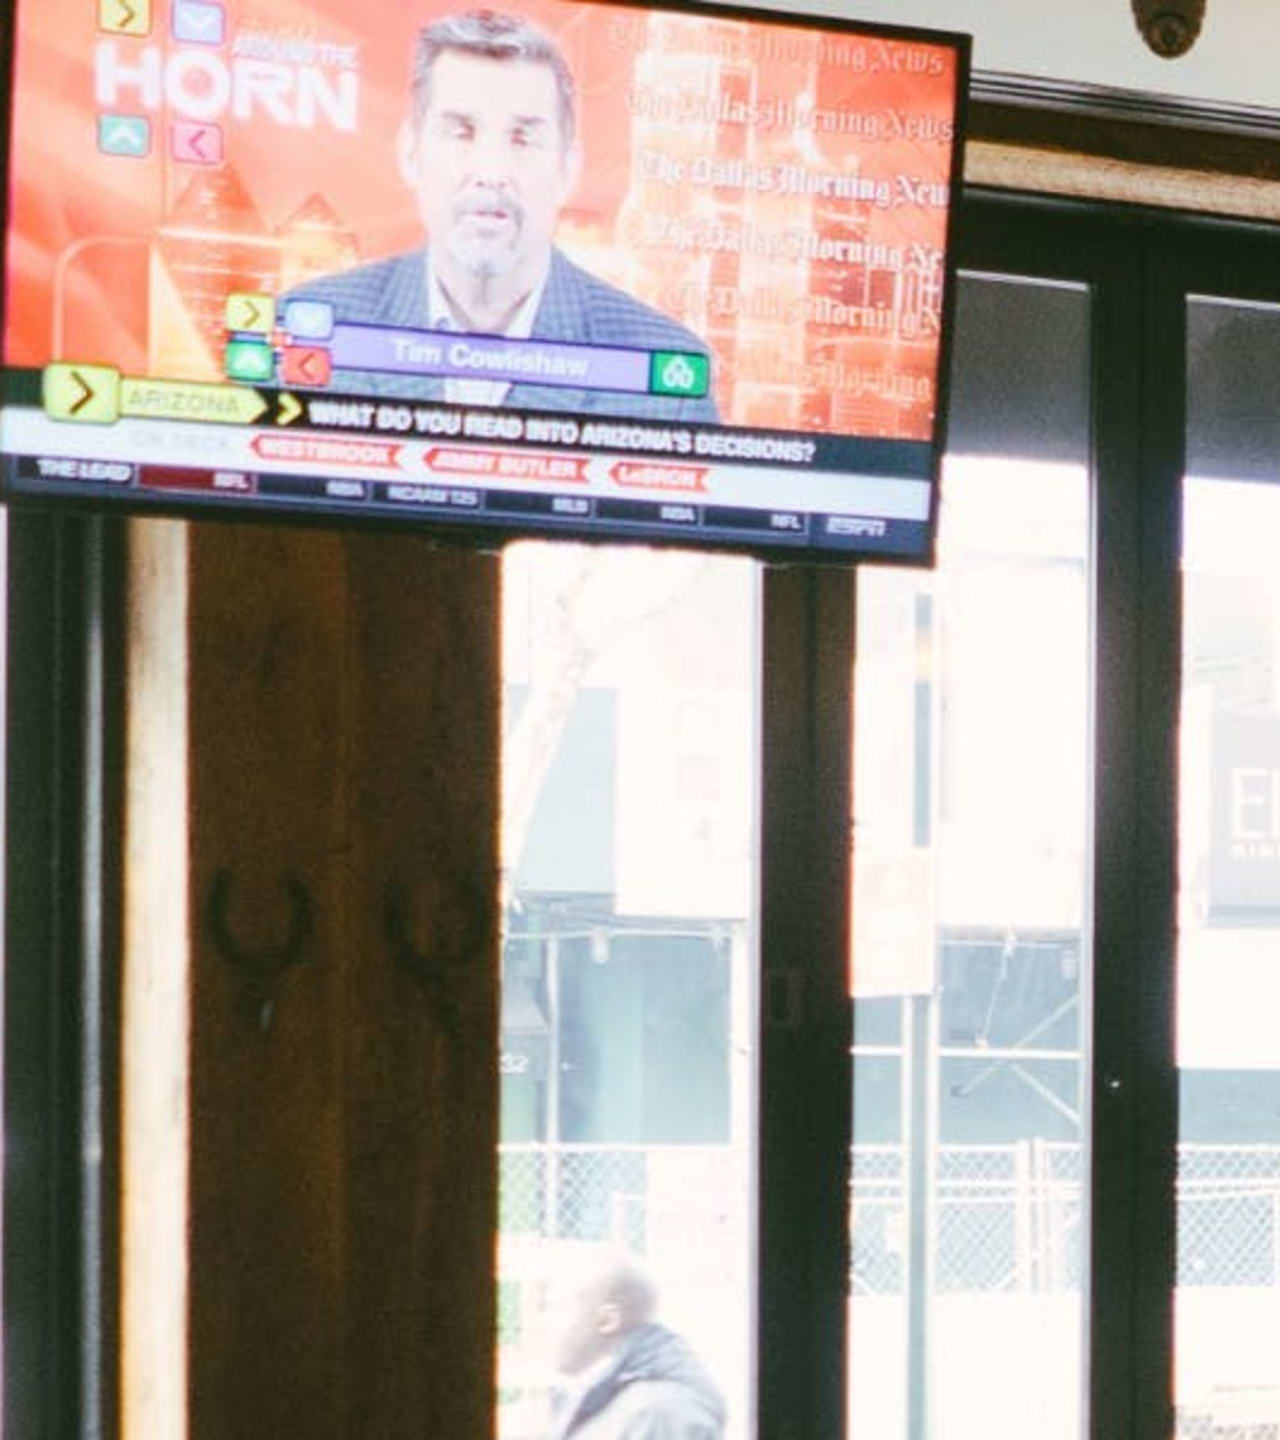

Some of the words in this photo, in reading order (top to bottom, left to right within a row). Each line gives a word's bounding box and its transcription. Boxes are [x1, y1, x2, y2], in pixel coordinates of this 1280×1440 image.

[94, 40, 358, 132] HORN
[395, 339, 441, 365] Tim
[129, 388, 239, 414] ARIZONA
[307, 401, 375, 427] WHAT
[376, 406, 412, 430] DO
[414, 409, 461, 434] YOU
[463, 413, 523, 439] READ
[525, 418, 578, 444] INTO
[581, 425, 692, 453] ARIZONA'S
[695, 432, 816, 463] DECISIONS?
[36, 459, 77, 478] THE
[79, 461, 133, 482] LEAD
[826, 515, 886, 536] ESPN
